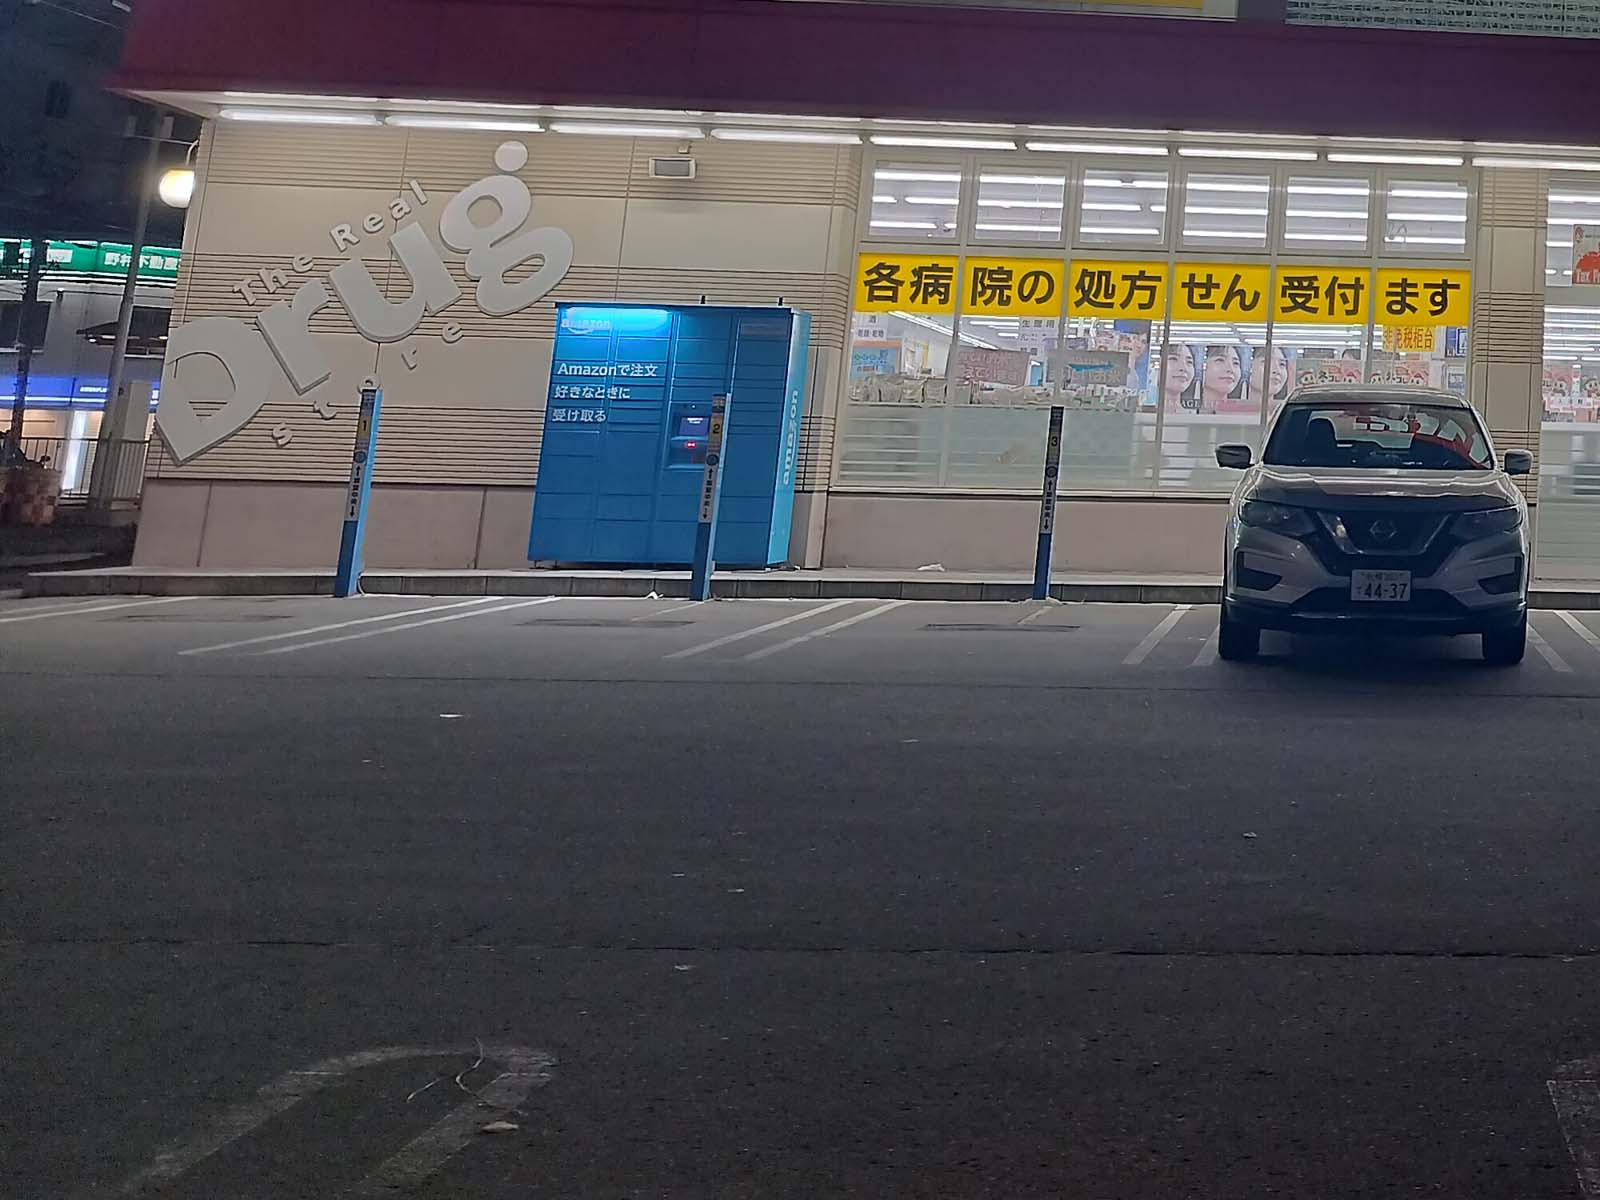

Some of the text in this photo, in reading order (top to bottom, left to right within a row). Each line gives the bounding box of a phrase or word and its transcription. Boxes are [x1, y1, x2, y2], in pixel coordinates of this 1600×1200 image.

[232, 179, 428, 305] The Real
[156, 140, 574, 467] Drug
[557, 363, 658, 377] Amazonで注文
[554, 385, 631, 399] 好きなときに
[552, 409, 606, 422] 受け取る
[713, 424, 720, 434] 2
[1051, 436, 1058, 446] 3
[1364, 583, 1408, 599] 44-37
